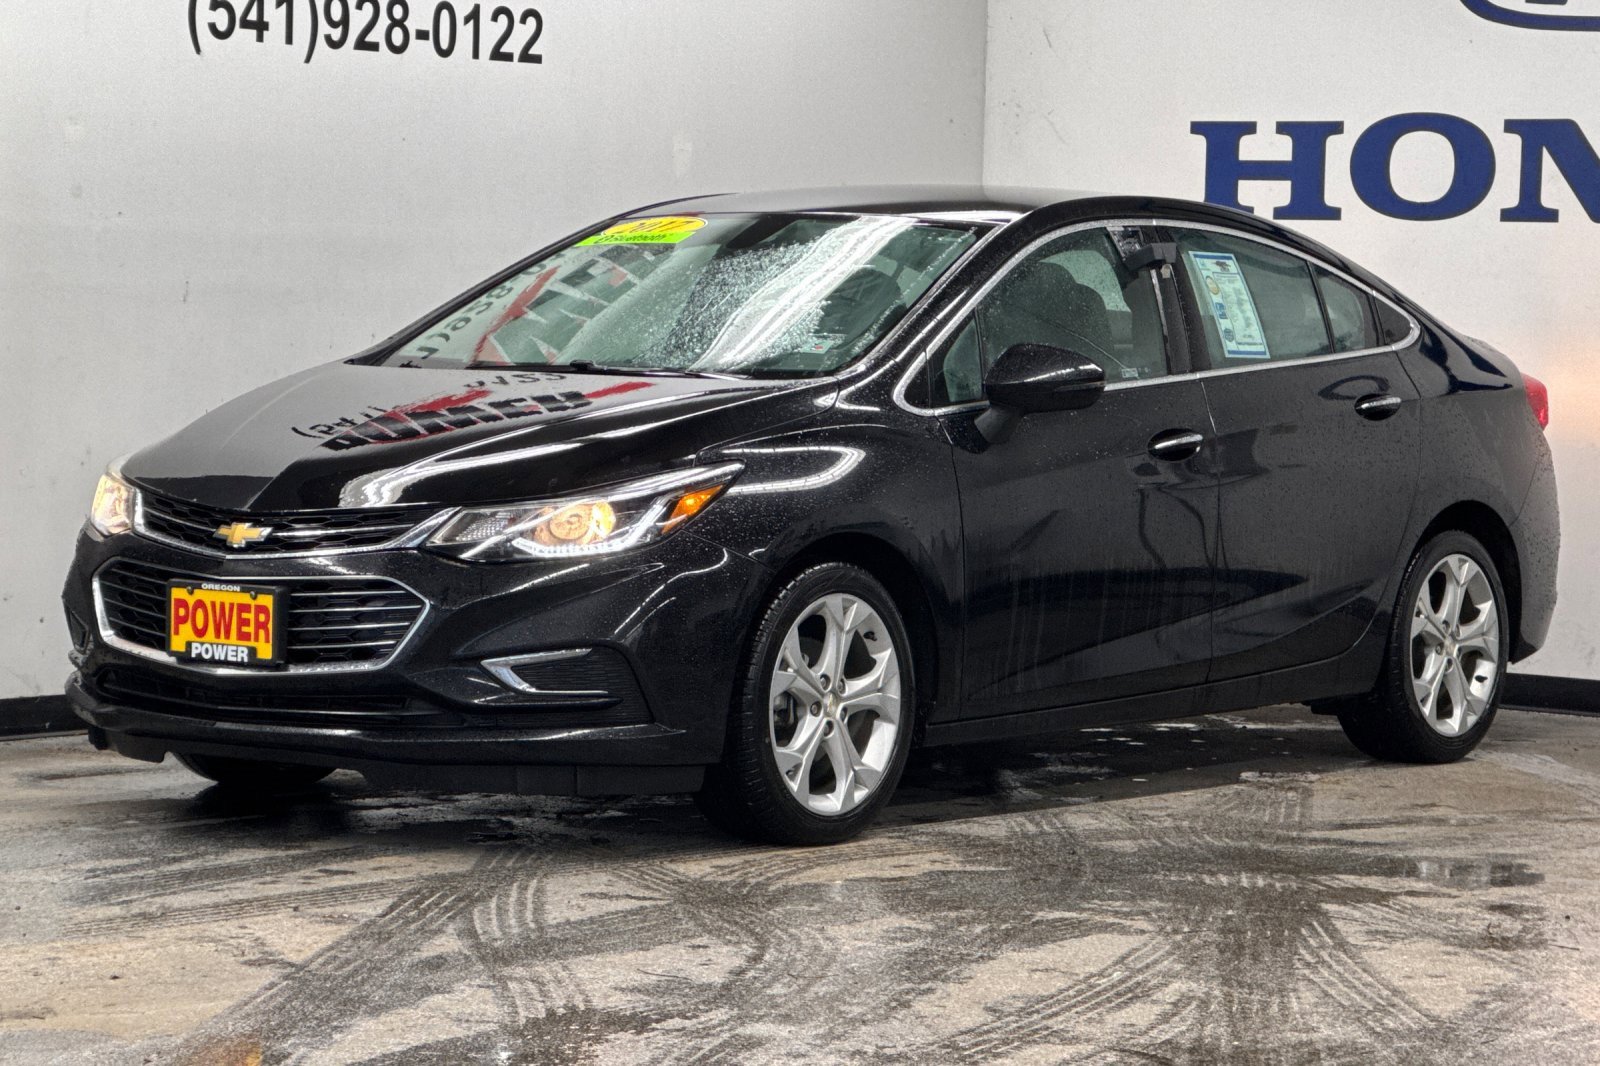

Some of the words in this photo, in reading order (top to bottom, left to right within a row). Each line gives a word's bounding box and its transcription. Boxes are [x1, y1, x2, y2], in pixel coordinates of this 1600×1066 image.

[188, 0, 543, 64] (541)928-0122
[201, 583, 241, 592] OREGON
[173, 597, 271, 644] POWER
[191, 642, 249, 663] POWER
